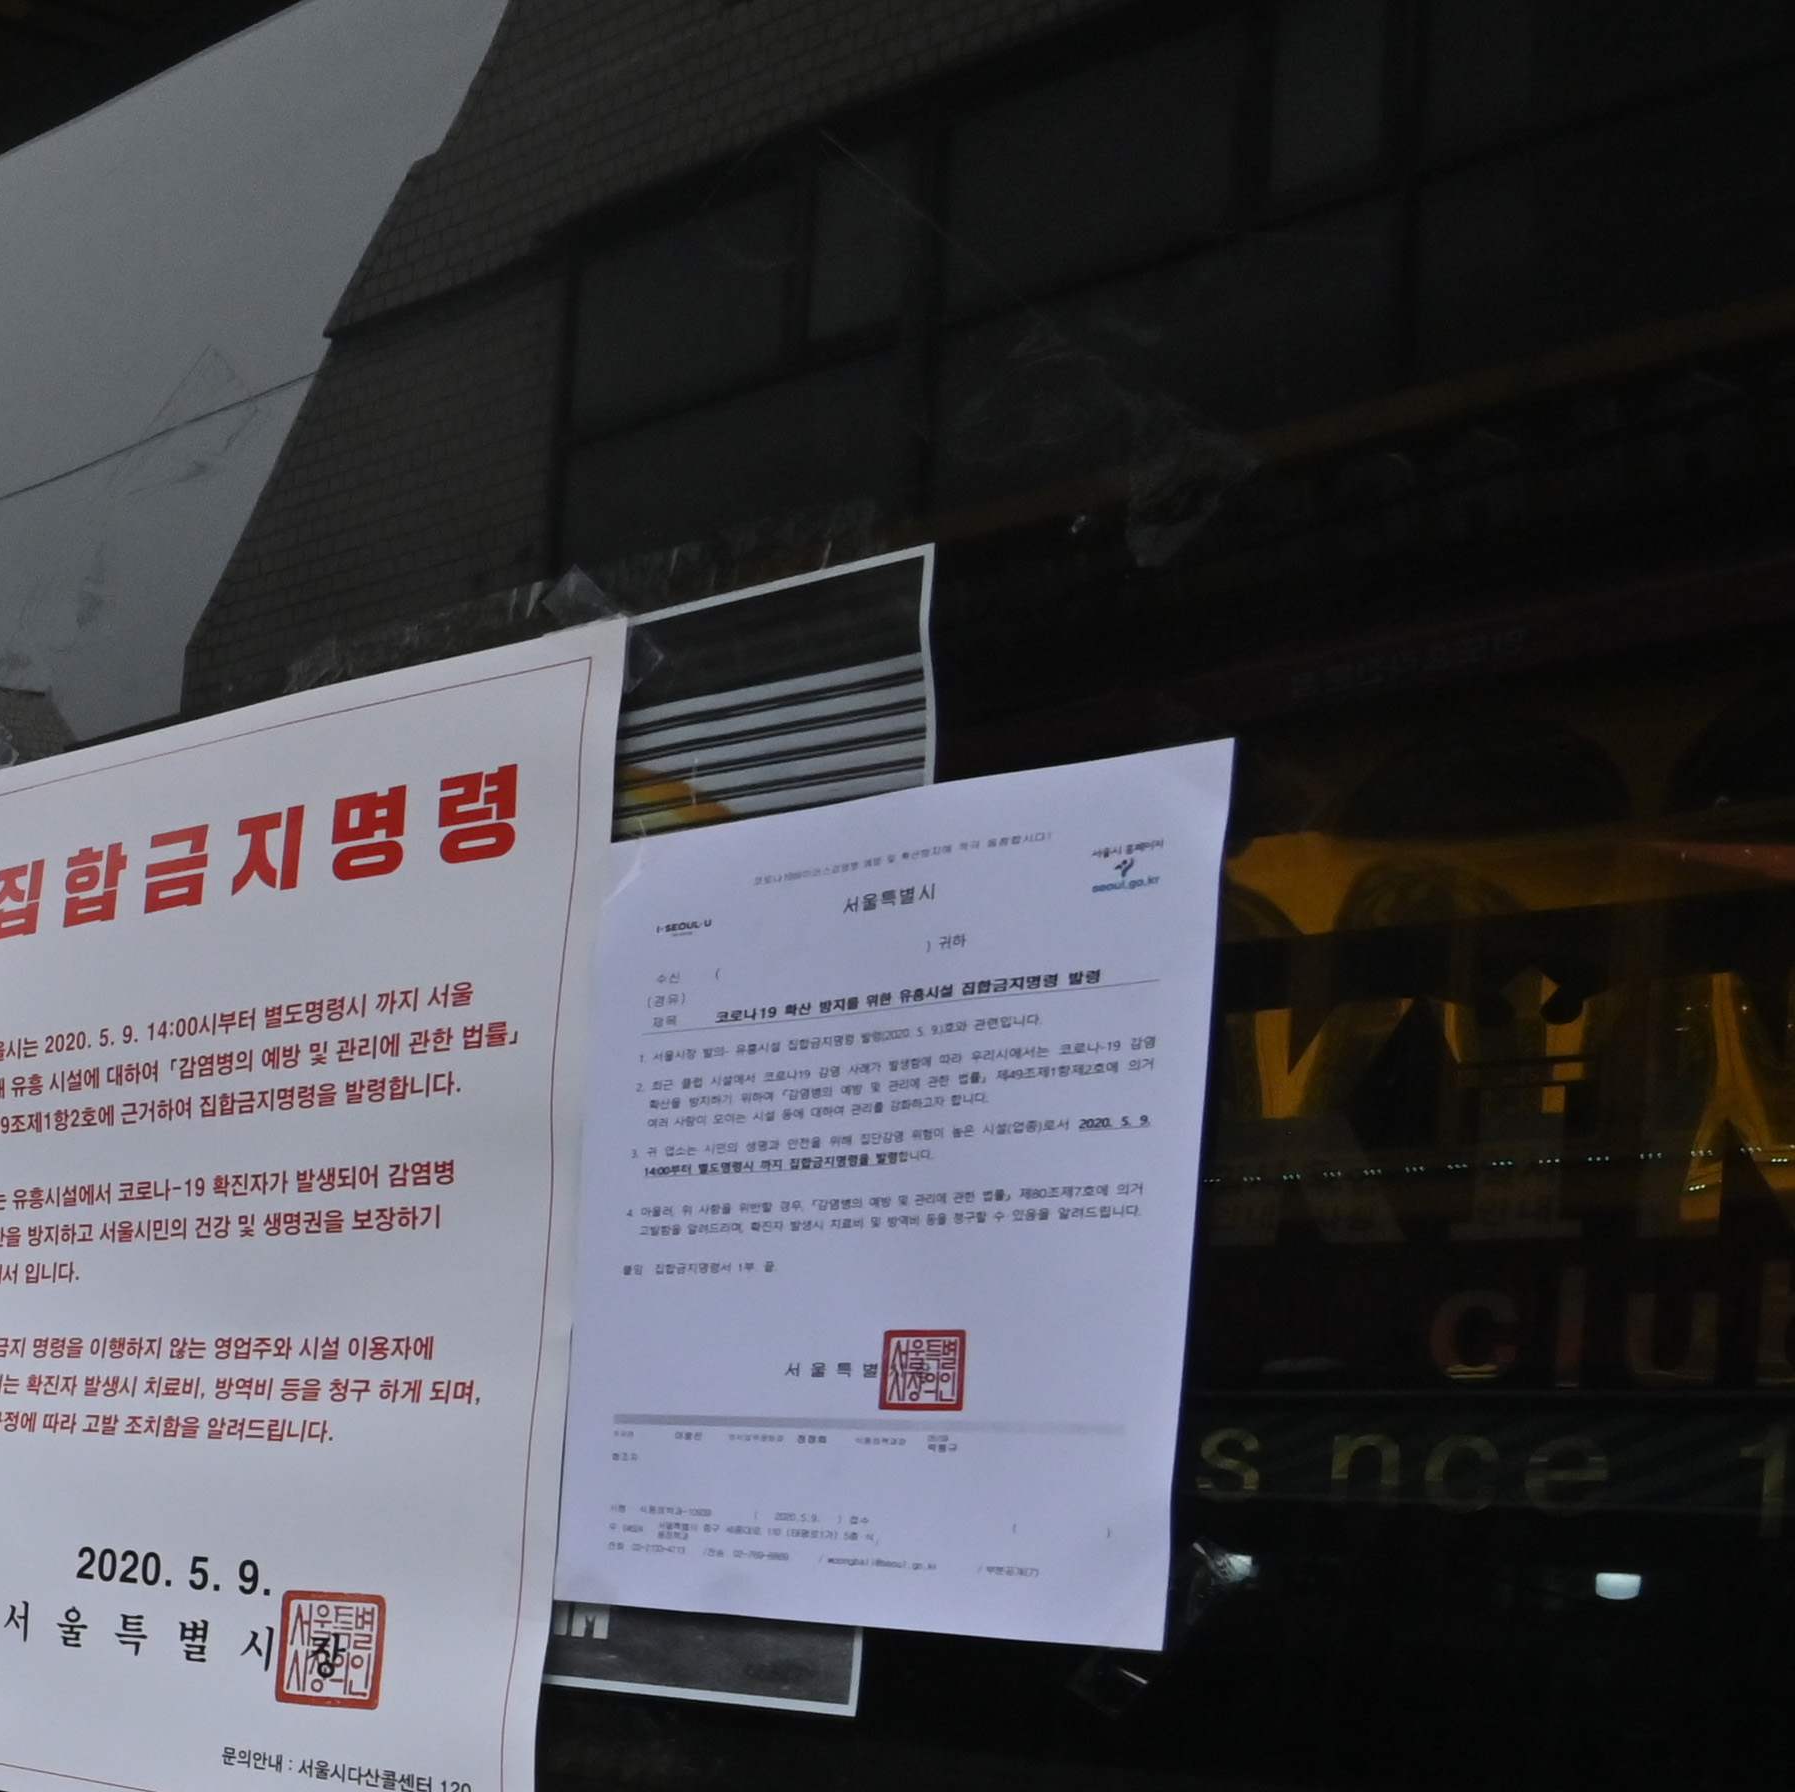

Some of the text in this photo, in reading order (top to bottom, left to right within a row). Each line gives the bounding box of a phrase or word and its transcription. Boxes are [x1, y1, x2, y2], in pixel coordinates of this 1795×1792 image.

[843, 883, 936, 914] 서울특별시
[1092, 875, 1160, 894] seoul.go.kr
[939, 933, 966, 950] 귀하
[715, 1006, 777, 1023] 코로나19
[784, 1002, 811, 1017] 확산
[819, 997, 859, 1014] 방지를
[866, 992, 891, 1009] 위한
[900, 984, 953, 1003] 유흥시설
[962, 973, 1058, 996] 집합금지명령
[1068, 969, 1101, 986] 발령
[44, 1031, 91, 1053] 2020.
[99, 1028, 114, 1047] 5.
[122, 1025, 138, 1044] 9.
[148, 1008, 256, 1040] 14:00시부터
[265, 994, 367, 1029] 별도명령시
[375, 988, 419, 1014] 까지
[427, 982, 473, 1008] 서울
[11, 1073, 43, 1097] 유흥
[49, 1067, 100, 1093] 시설에
[107, 1060, 158, 1087] 대하여
[262, 1044, 300, 1070] 예방
[309, 1041, 328, 1065] 및
[336, 1033, 401, 1062] 관리에
[409, 1027, 453, 1055] 관한
[121, 1097, 192, 1125] 근거하여
[200, 1081, 337, 1118] 집합금지명령을
[345, 1071, 461, 1105] 발령합니다.
[12, 1182, 111, 1210] 유흥시설에서
[118, 1177, 205, 1202] 코로나-19
[213, 1169, 289, 1198] 확진자가
[297, 1164, 378, 1193] 발생되어
[389, 1159, 454, 1188] 감염병
[28, 1223, 93, 1247] 방지하고
[100, 1217, 187, 1243] 서울시민의
[195, 1215, 231, 1239] 건강
[238, 1213, 255, 1237] 및
[263, 1209, 344, 1237] 생명권을
[352, 1204, 441, 1232] 보장하기
[25, 1262, 80, 1284] 입니다.
[33, 1337, 84, 1359] 명령을
[90, 1336, 162, 1360] 이행하지
[169, 1336, 206, 1360] 않는
[214, 1336, 292, 1360] 영업주와
[299, 1336, 340, 1360] 시설
[348, 1336, 435, 1361] 이용자에
[27, 1375, 78, 1397] 확진자
[84, 1375, 137, 1398] 발생시
[143, 1376, 205, 1400] 치료비,
[215, 1377, 273, 1401] 방역비
[280, 1378, 321, 1402] 등을
[329, 1378, 372, 1403] 청구
[379, 1379, 421, 1404] 하게
[429, 1379, 481, 1406] 되며,
[43, 1412, 77, 1434] 따라
[82, 1413, 118, 1436] 고발
[124, 1415, 200, 1439] 조치함을
[207, 1416, 334, 1443] 알려드립니다.
[76, 1546, 271, 1596] 2020. 5. 9.
[222, 1747, 283, 1772] 문의안내
